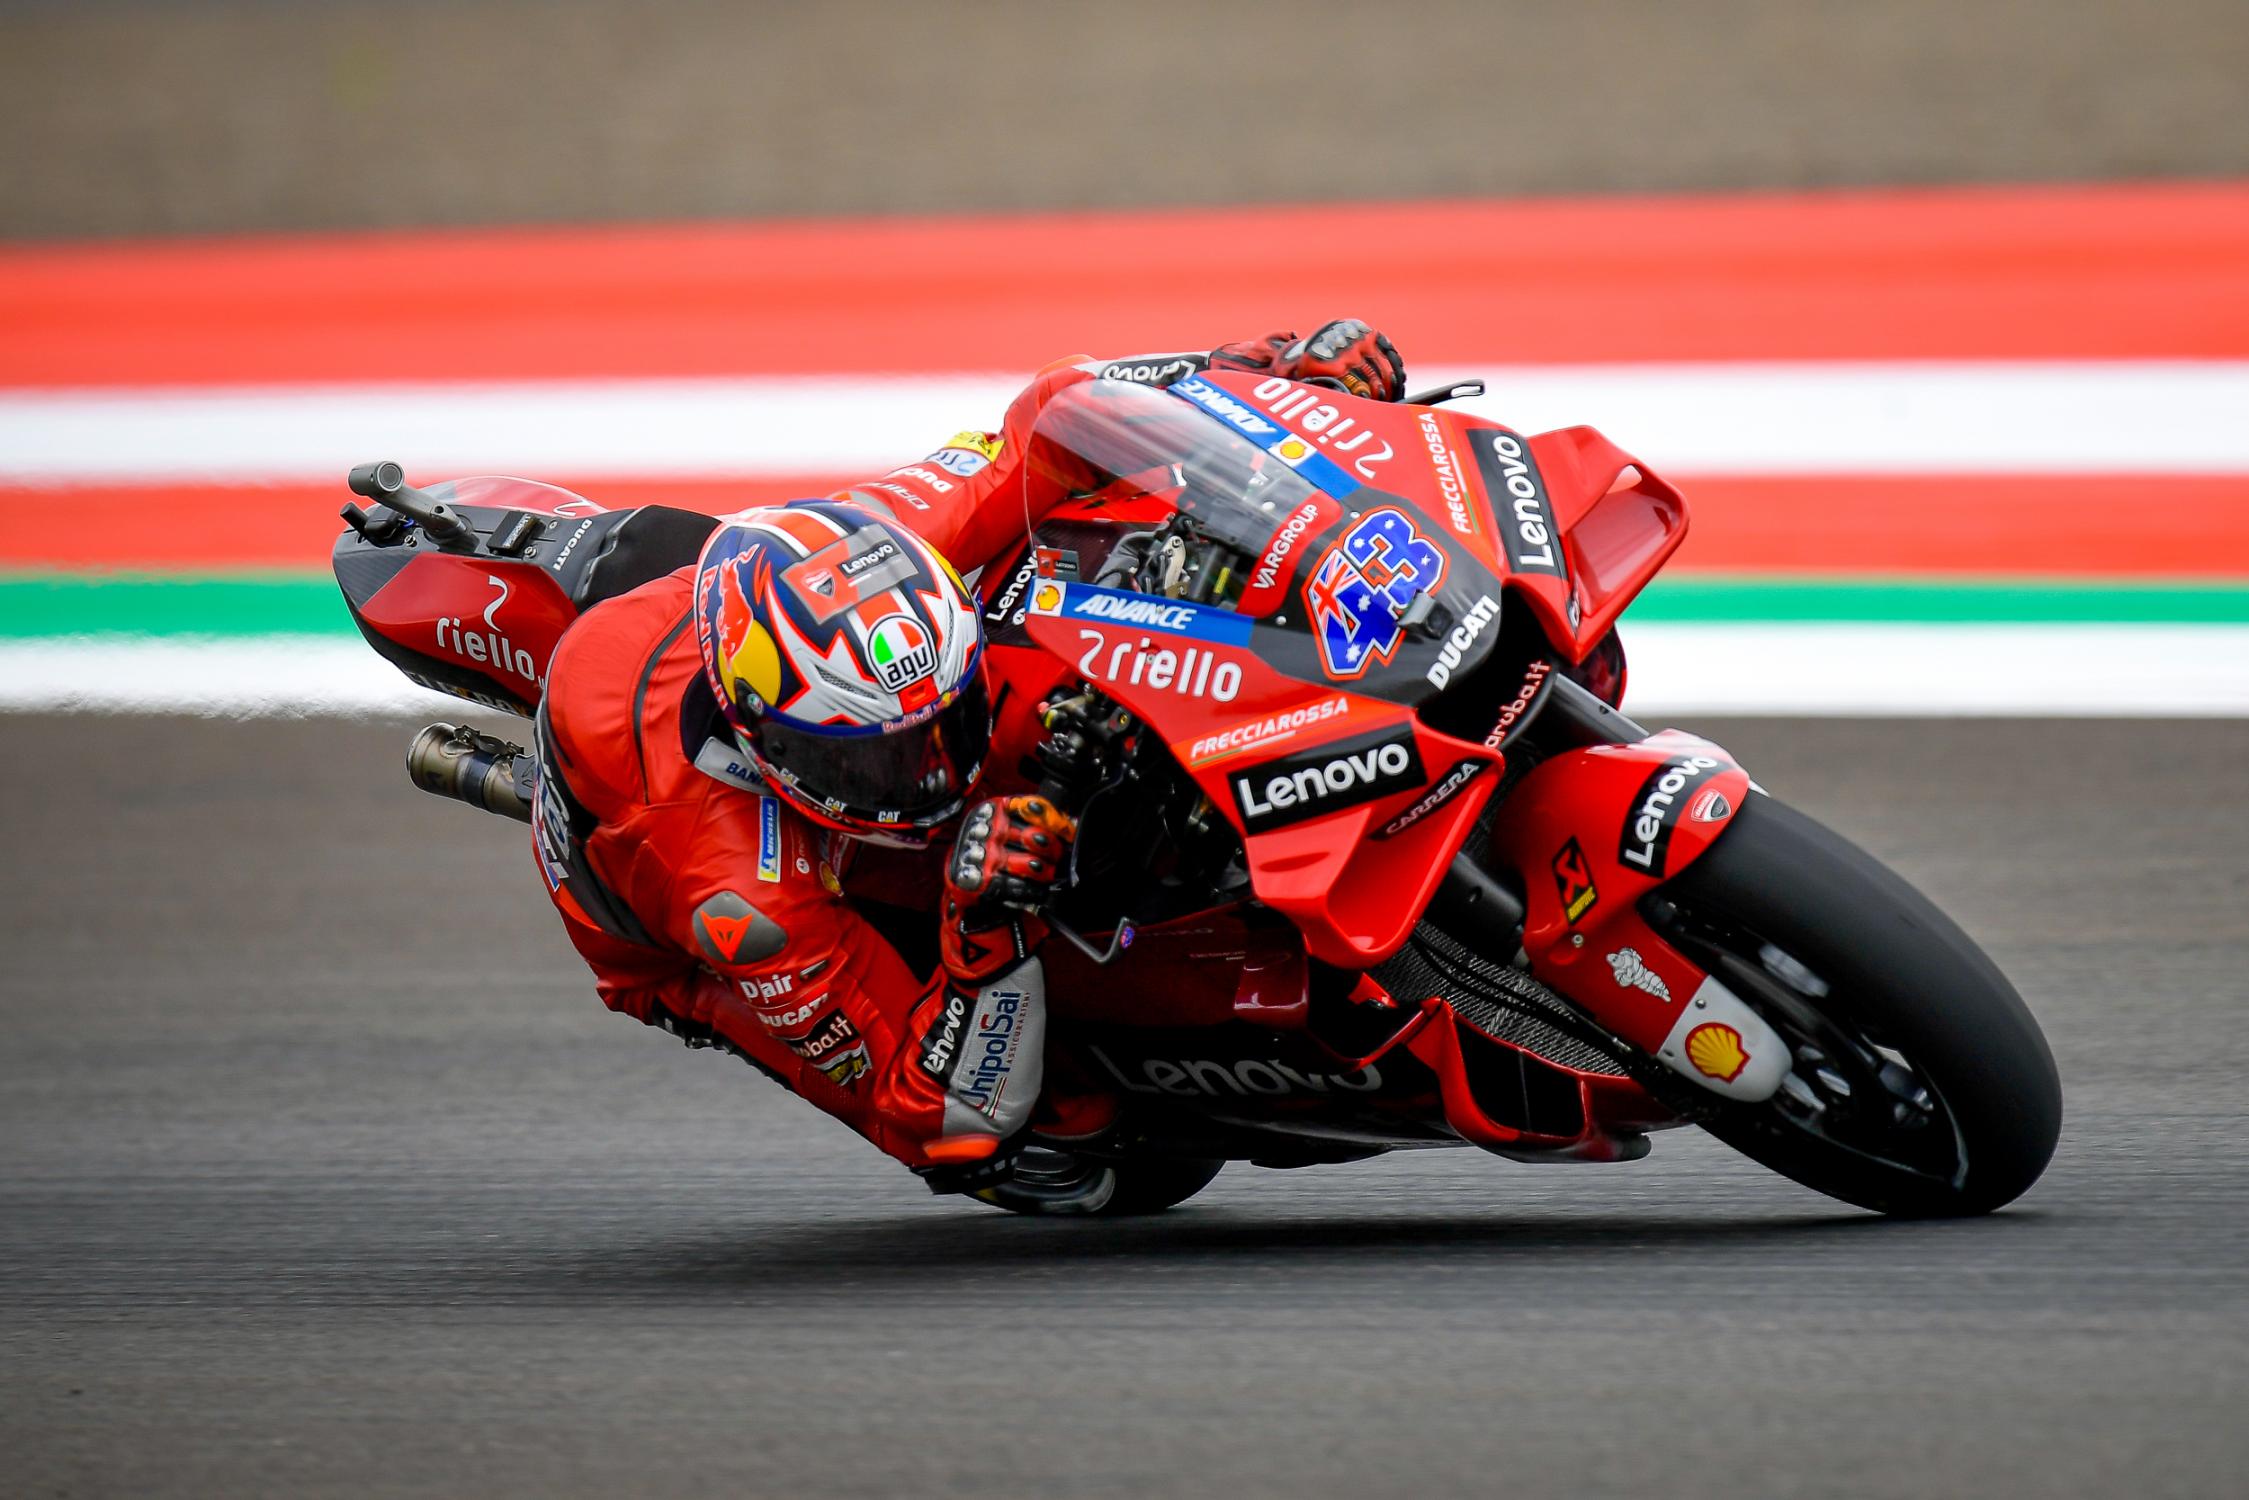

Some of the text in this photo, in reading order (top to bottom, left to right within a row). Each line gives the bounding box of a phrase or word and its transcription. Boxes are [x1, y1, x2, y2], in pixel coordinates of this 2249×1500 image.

[1253, 378, 1373, 451] riello
[1418, 412, 1473, 535] FRECCIAROSSA
[1493, 435, 1555, 568] Lenovo
[553, 518, 593, 571] DUCATI
[842, 544, 894, 574] Lenovo
[1252, 504, 1319, 590] VARGROUP
[1074, 594, 1197, 630] ADVANCE
[1305, 507, 1447, 678] 43
[437, 617, 535, 682] riello
[887, 645, 931, 684] agv
[1107, 637, 1243, 703] riello
[1426, 595, 1501, 692] DUCATI
[1190, 697, 1349, 759] FRECCIAROSSA
[779, 768, 799, 785] CAT
[825, 796, 848, 812] CAT
[1238, 743, 1410, 818] Lenovo
[1386, 761, 1480, 835] CARRERA
[1625, 757, 1718, 868] Lenovo
[877, 810, 900, 823] CAT
[958, 991, 1021, 1110] UnipolSai
[1007, 992, 1031, 1065] ASSICURAZIONI
